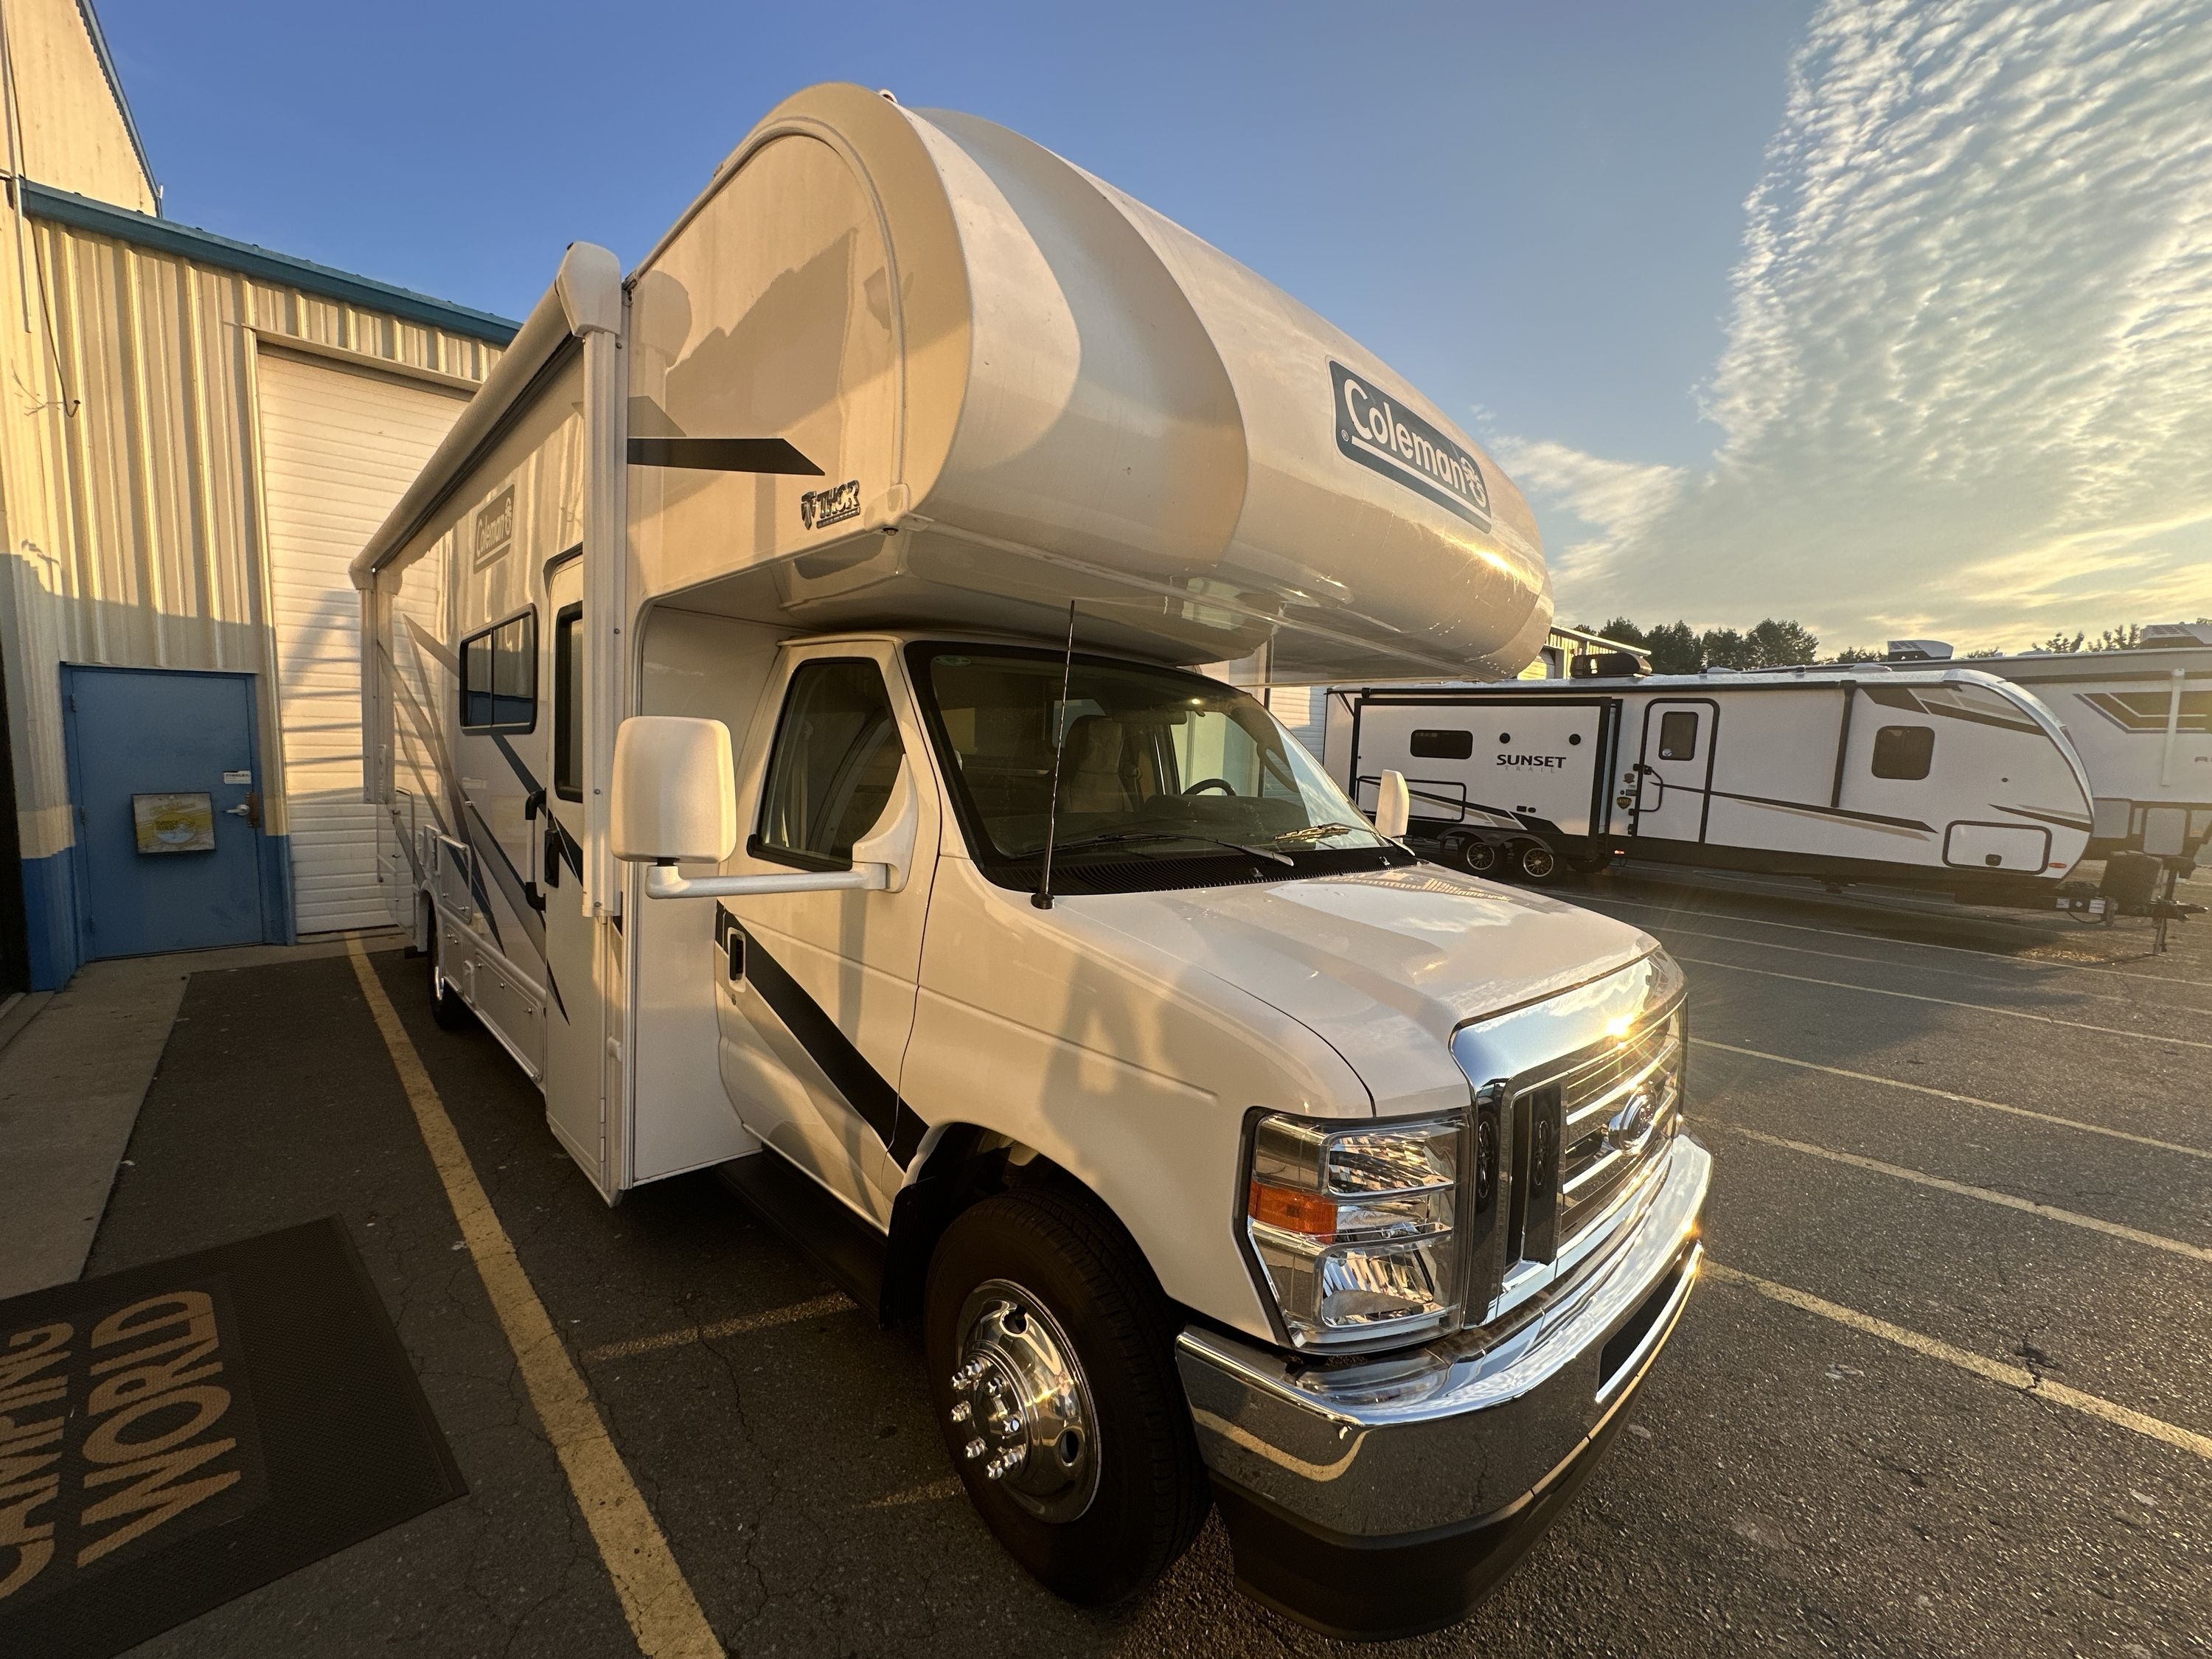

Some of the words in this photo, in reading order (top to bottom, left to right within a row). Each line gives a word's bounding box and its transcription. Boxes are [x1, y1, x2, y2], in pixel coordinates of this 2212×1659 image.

[1343, 378, 1467, 495] Coleman
[816, 479, 860, 518] THOR
[1496, 754, 1567, 768] SUNSET
[1504, 765, 1556, 773] TRAIL
[77, 1290, 241, 1569] WORLD
